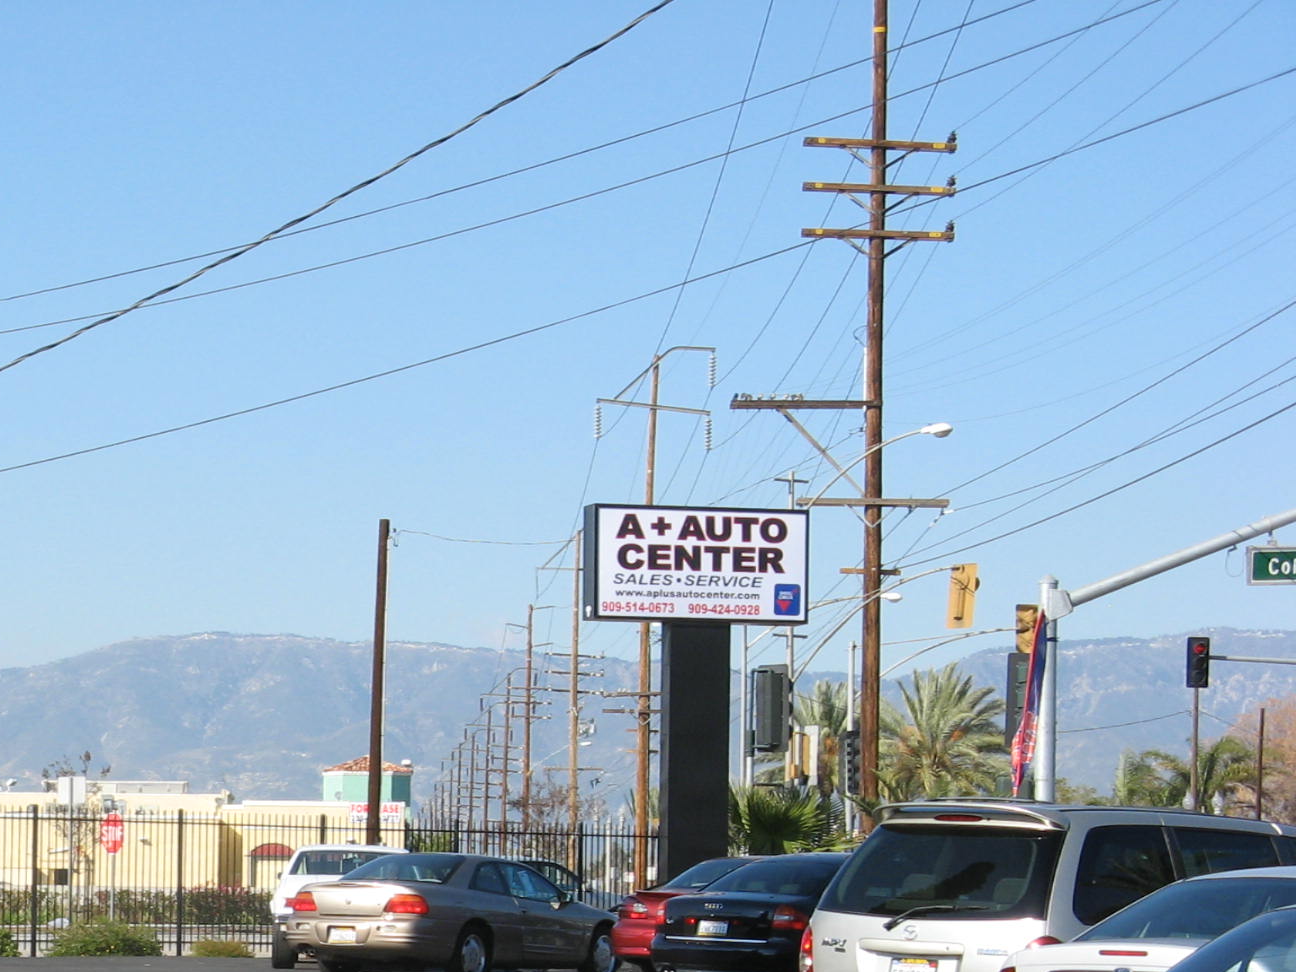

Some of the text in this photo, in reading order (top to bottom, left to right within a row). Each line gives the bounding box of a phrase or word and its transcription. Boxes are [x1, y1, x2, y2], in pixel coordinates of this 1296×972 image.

[677, 515, 788, 544] AUTO
[617, 543, 785, 574] CENTER
[615, 590, 760, 601] www.aplusautocenter.com
[602, 602, 760, 615] 909-514-0673 909-424-0928
[101, 826, 123, 840] STOP
